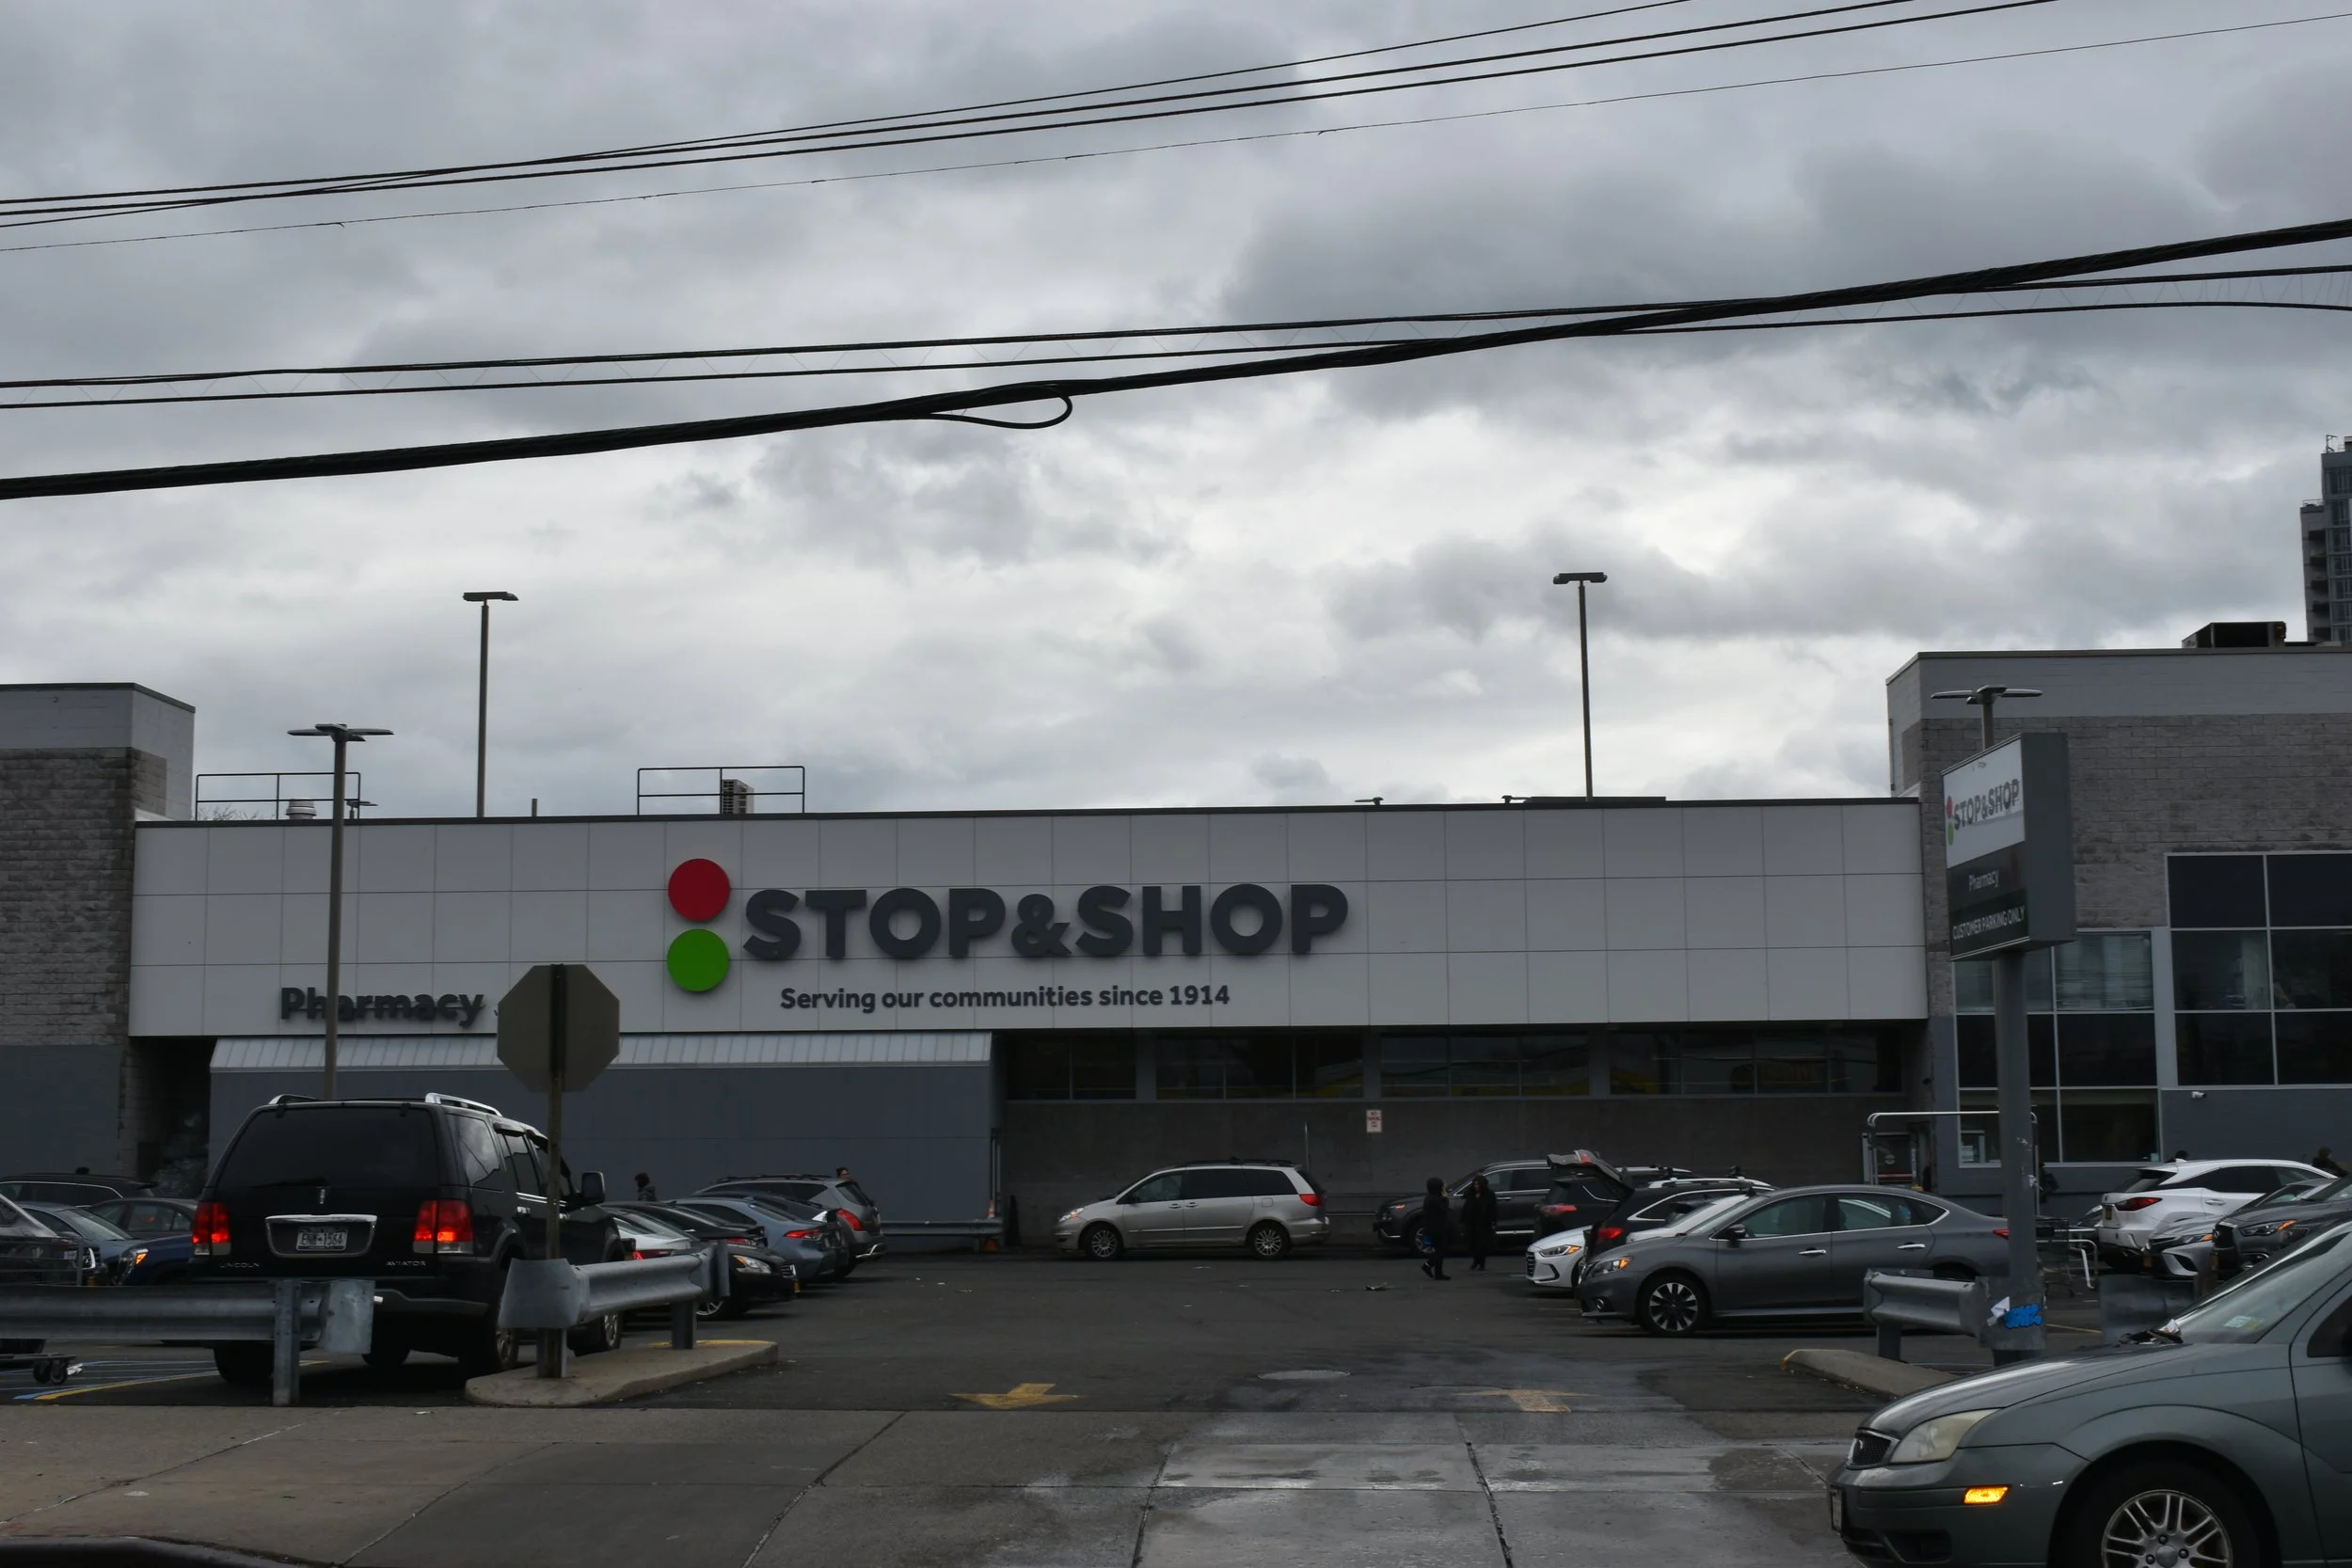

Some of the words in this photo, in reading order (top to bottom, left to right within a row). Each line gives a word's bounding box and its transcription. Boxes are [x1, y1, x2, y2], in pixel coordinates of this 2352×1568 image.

[1954, 778, 2020, 831] STOP&SHOP
[1968, 870, 1999, 892] Pharmacy
[743, 883, 1348, 960] STOP&SHOP
[1953, 917, 1982, 940] CUSTOMER
[1981, 910, 2008, 932] PARKING
[2007, 905, 2026, 925] ONLY
[280, 987, 485, 1027] Pharmacy
[780, 988, 876, 1014] Serving
[882, 990, 925, 1008] our
[930, 986, 1093, 1008] communities
[1099, 985, 1163, 1006] since
[1169, 984, 1231, 1006] 1914
